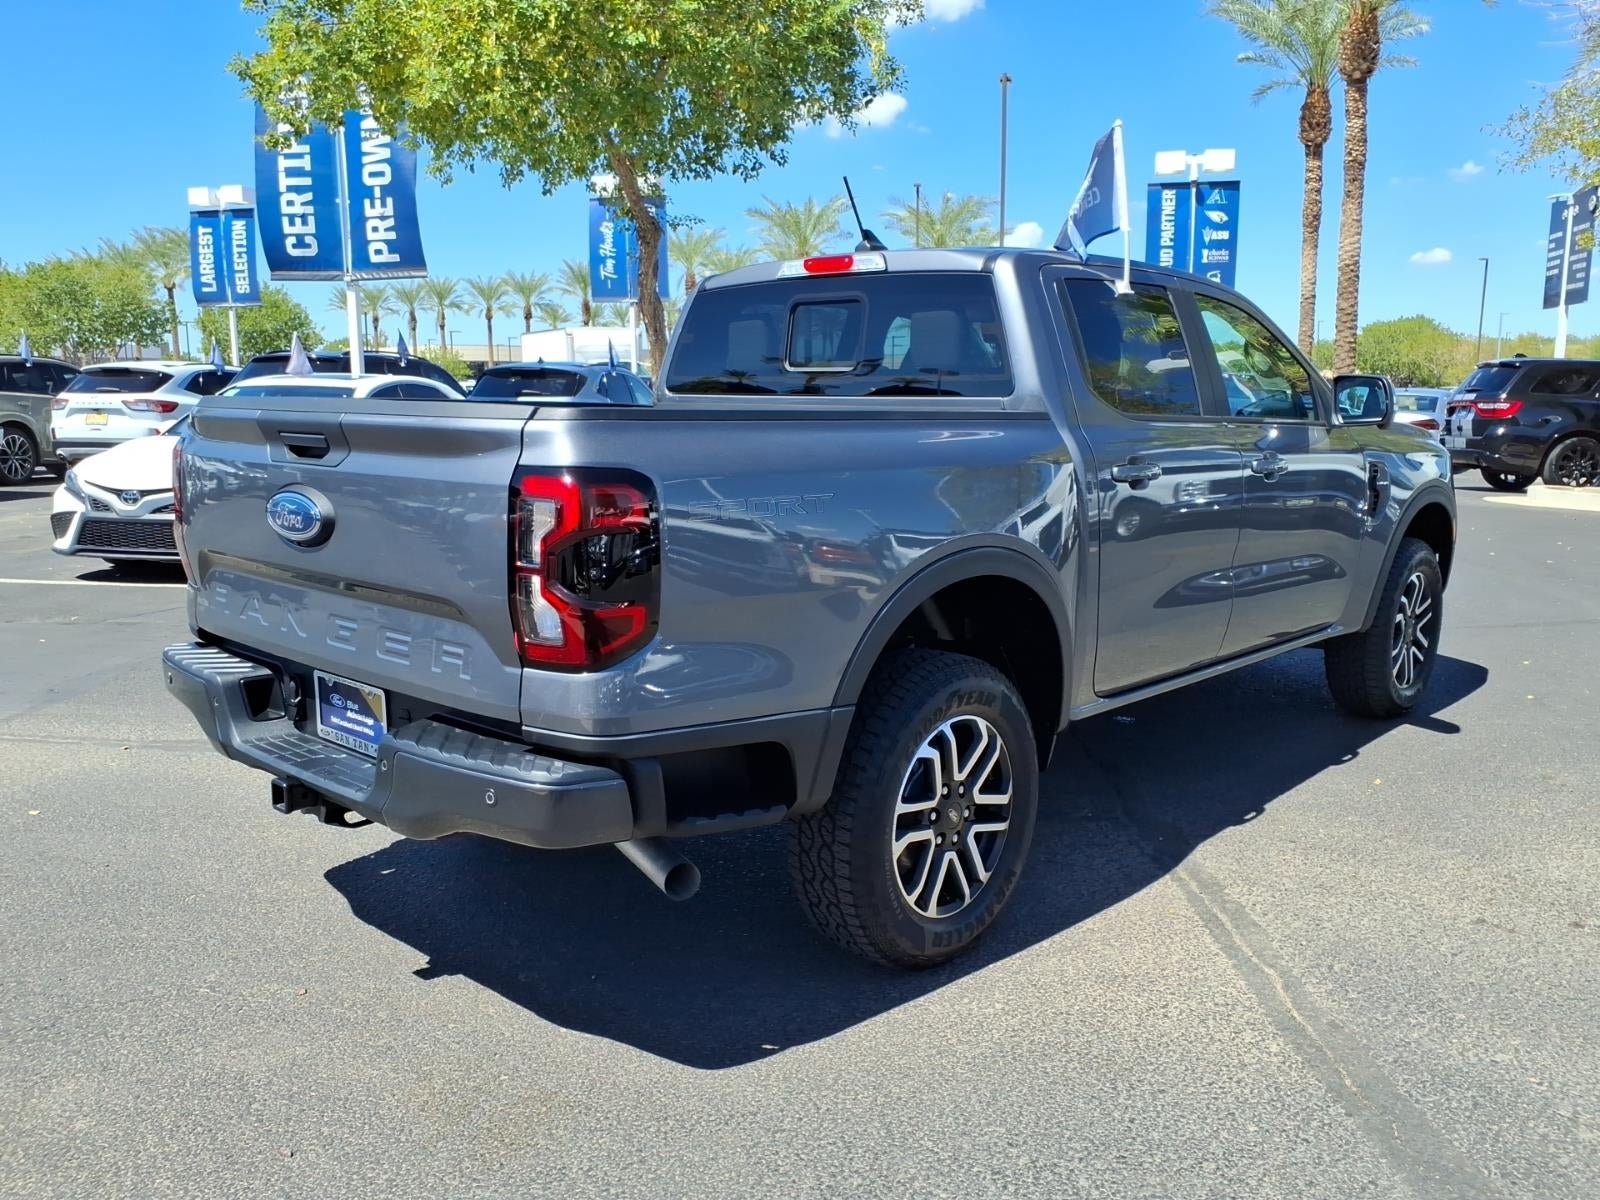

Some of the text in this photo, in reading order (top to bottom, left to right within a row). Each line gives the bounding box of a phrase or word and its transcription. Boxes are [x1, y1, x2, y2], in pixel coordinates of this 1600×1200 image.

[1160, 189, 1176, 247] PARTNER
[198, 225, 217, 292] LARGEST
[231, 220, 250, 294] SELECTION
[275, 502, 305, 529] Ford
[688, 493, 835, 522] SPORT
[204, 583, 473, 681] RANGER
[335, 732, 350, 745] SAN
[353, 740, 369, 752] TAN
